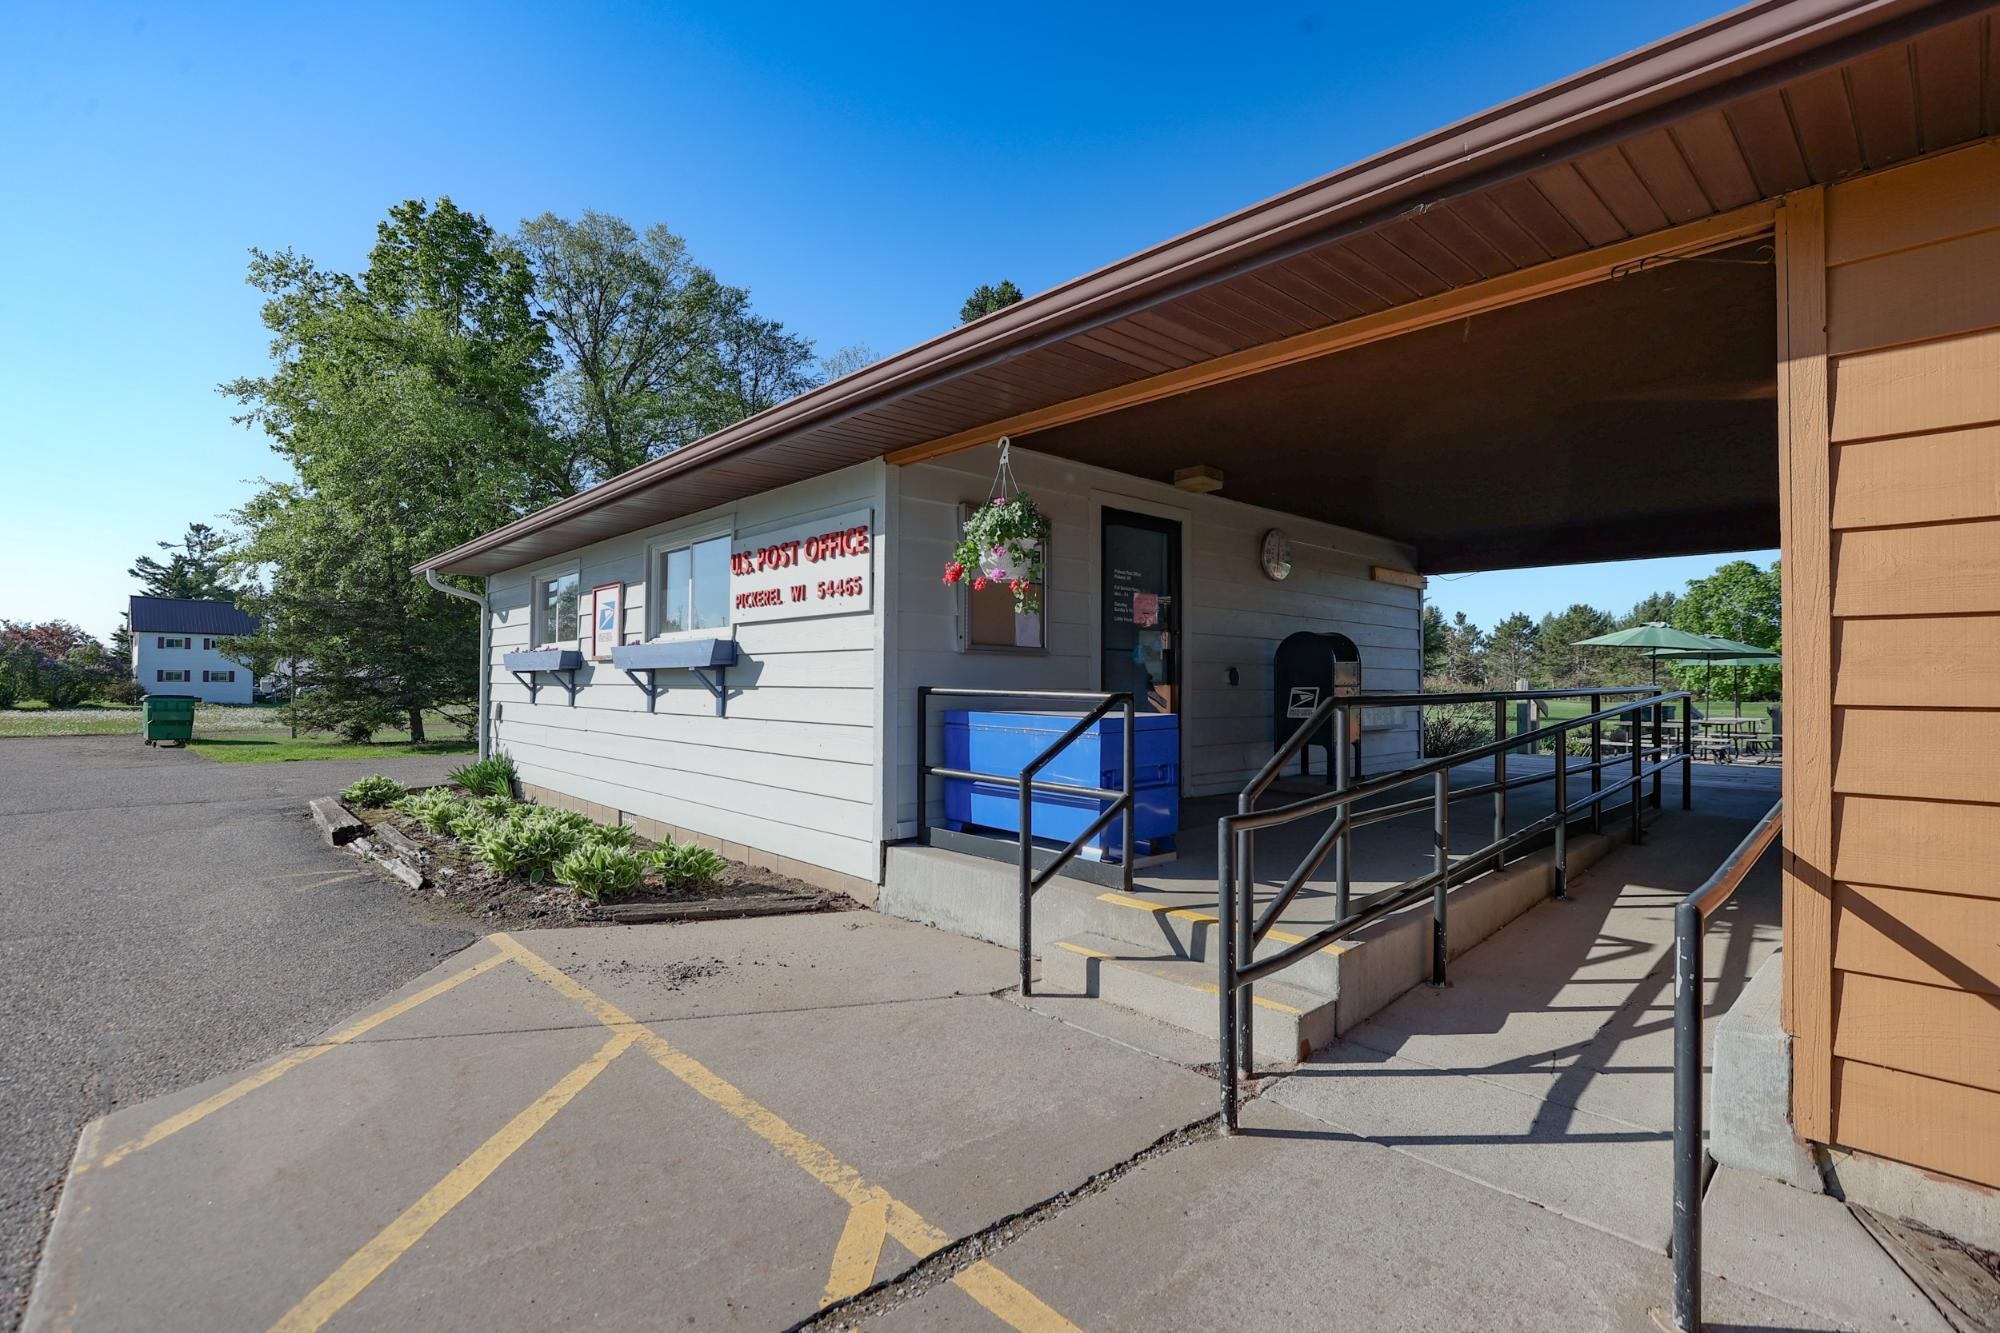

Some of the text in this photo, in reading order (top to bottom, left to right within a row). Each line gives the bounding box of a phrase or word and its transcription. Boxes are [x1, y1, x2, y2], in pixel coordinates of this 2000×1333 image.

[731, 525, 869, 577] U.S. POST OFFICE
[736, 576, 863, 609] PICKEREL WI 54465
